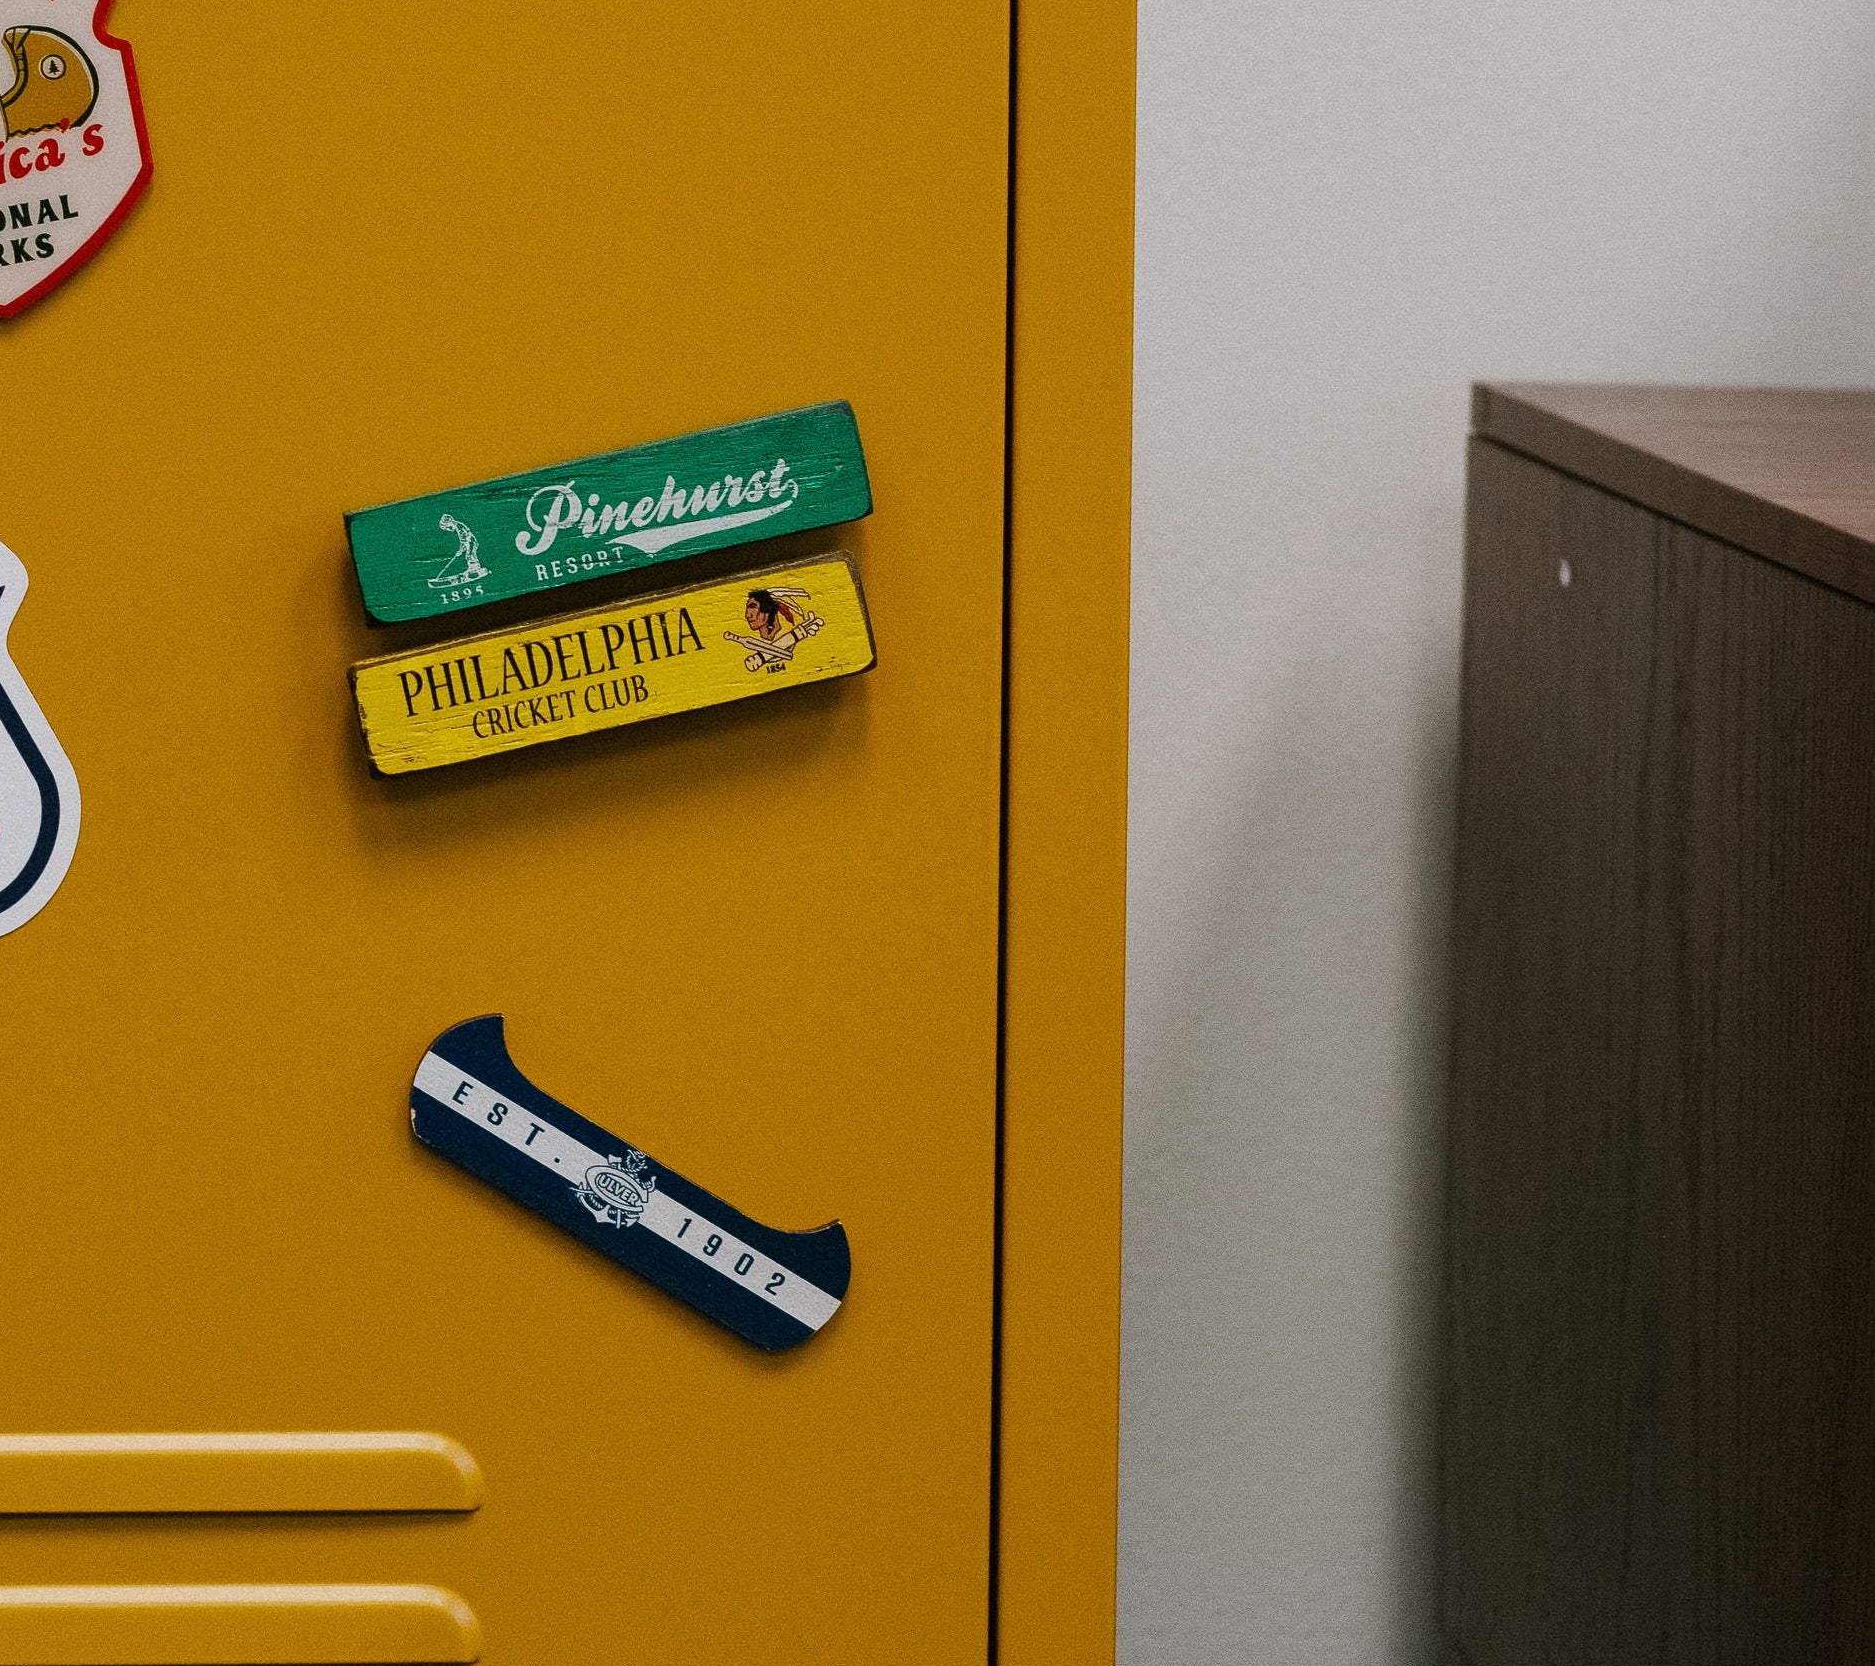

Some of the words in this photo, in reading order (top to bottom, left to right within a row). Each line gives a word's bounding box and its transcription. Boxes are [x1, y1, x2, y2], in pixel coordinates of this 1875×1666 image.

[515, 457, 800, 557] Pinehurst
[440, 585, 484, 605] 1895
[536, 545, 627, 582] RESORT
[397, 605, 706, 718] PHILADELPHIA
[472, 689, 579, 741] CRICKET
[583, 673, 650, 715] CLUB
[451, 1080, 562, 1164] EST.
[676, 1217, 787, 1297] 1902
